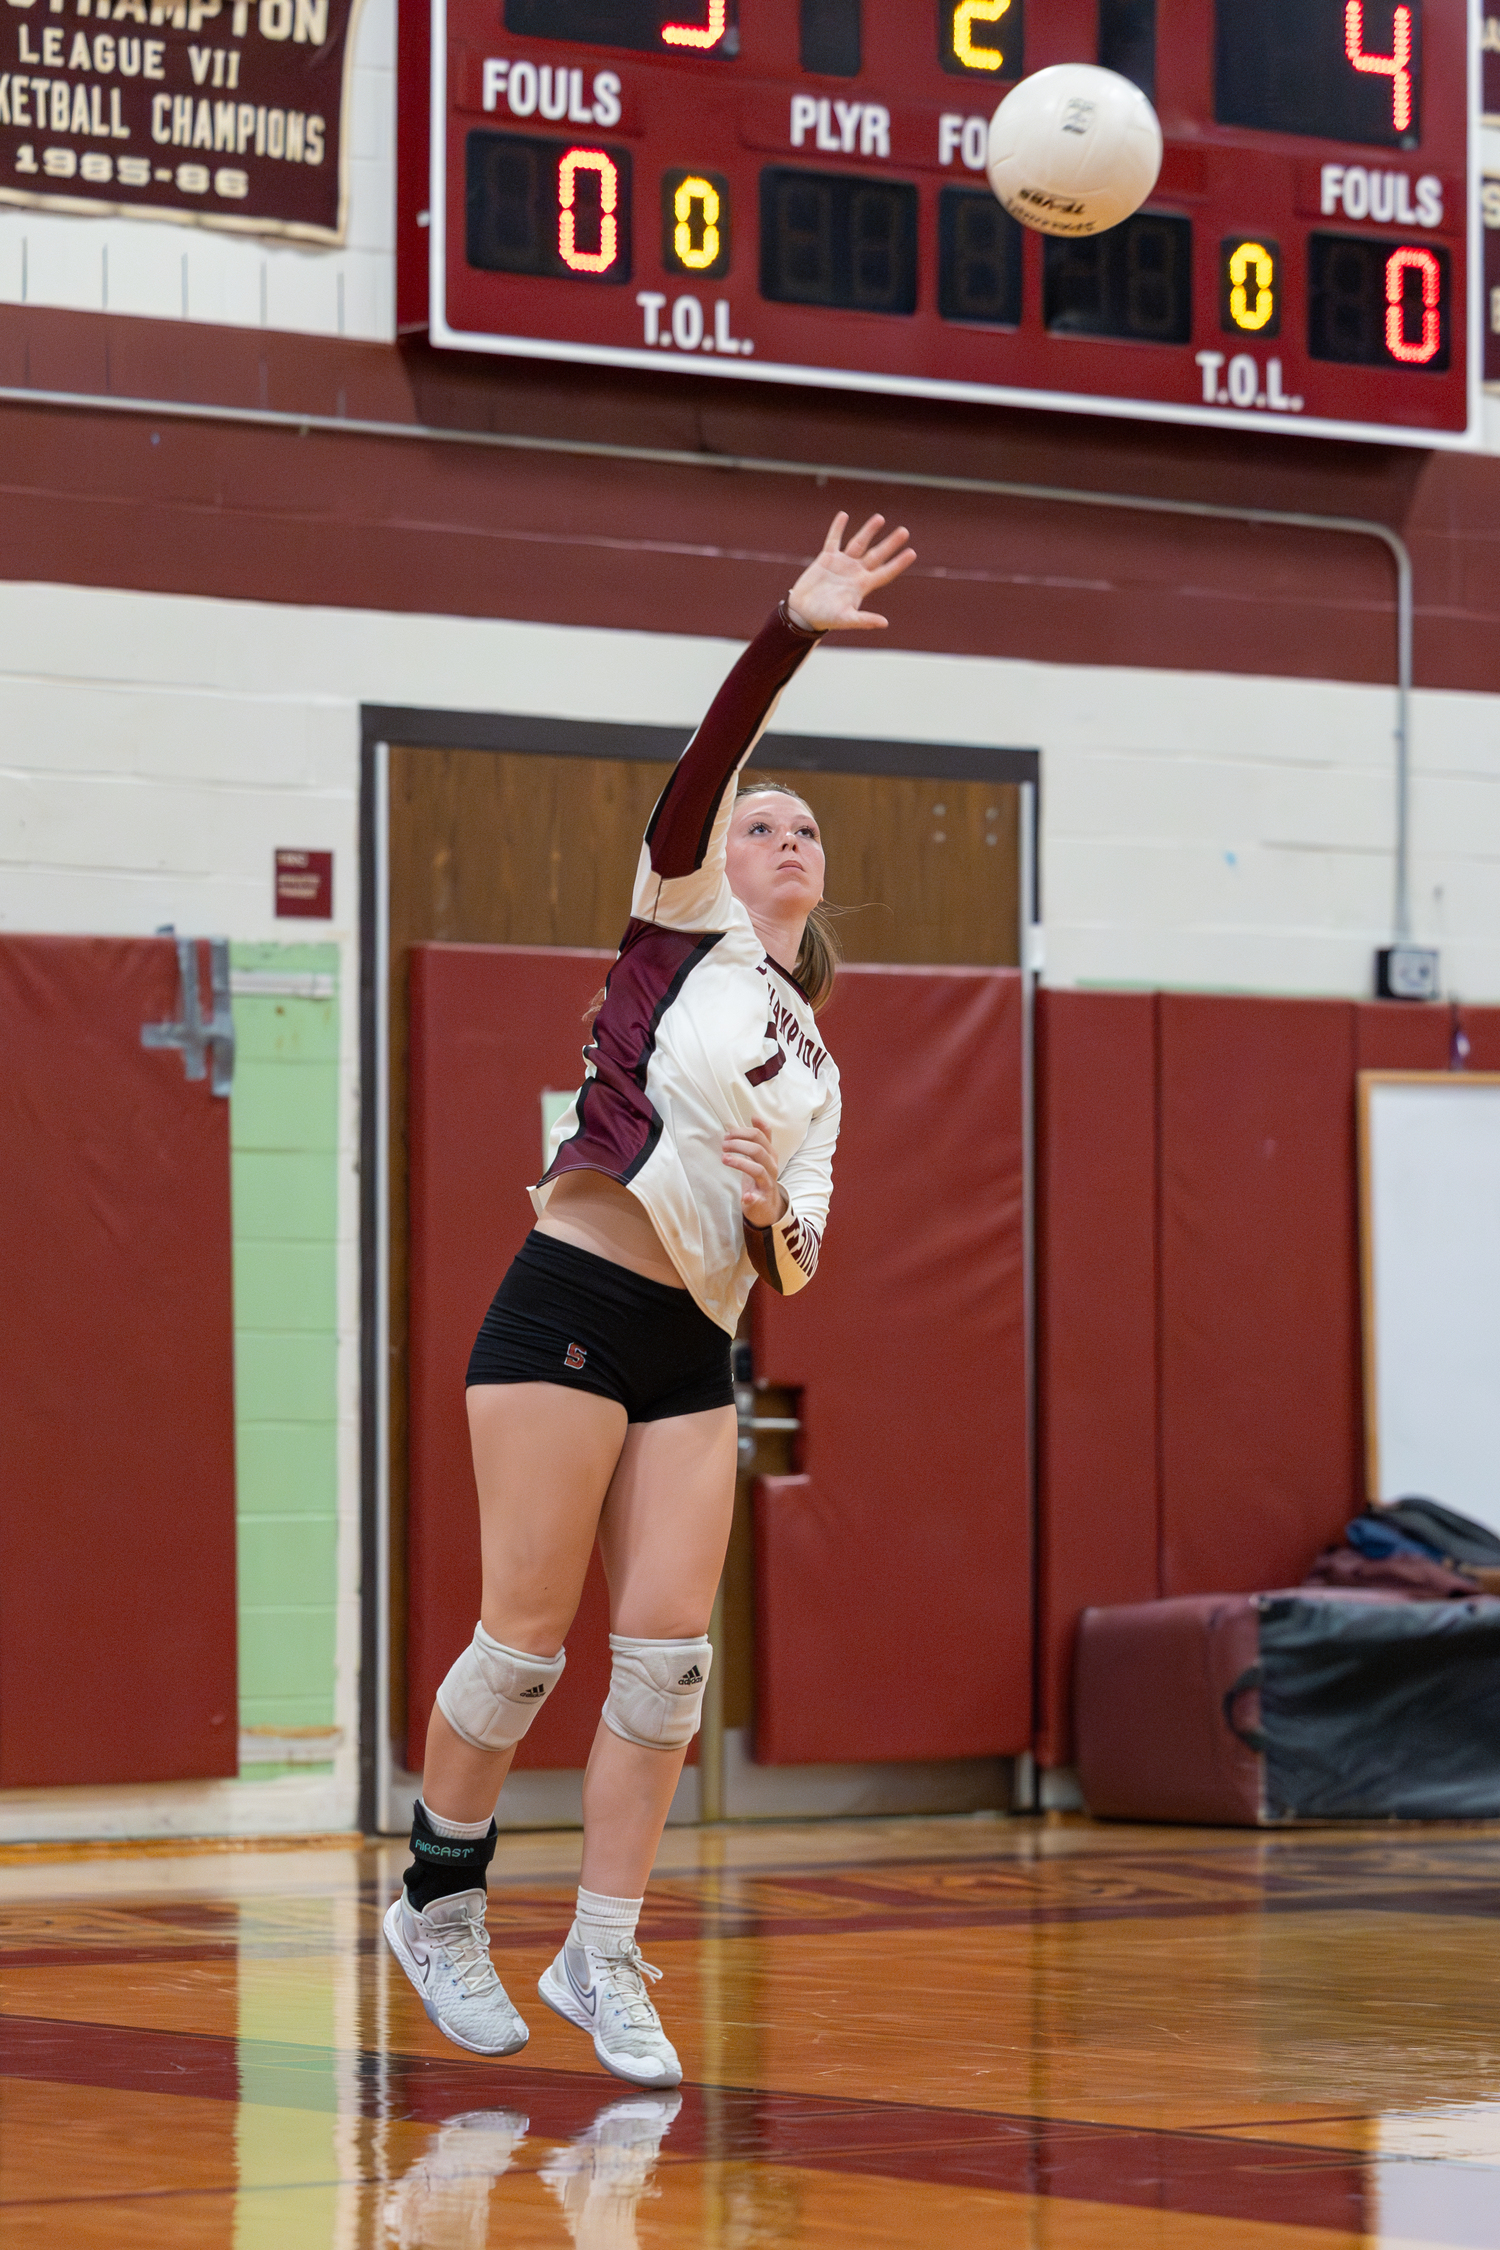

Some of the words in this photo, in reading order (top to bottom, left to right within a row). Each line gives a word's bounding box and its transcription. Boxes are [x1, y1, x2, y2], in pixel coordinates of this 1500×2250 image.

[19, 24, 165, 80] LEAGUE
[188, 45, 240, 89] VII
[1344, 0, 1411, 131] 4
[482, 58, 621, 127] FOULS
[790, 95, 890, 157] PLYR
[152, 93, 325, 166] CHAMPIONS
[15, 145, 248, 199] 1985-86
[1321, 164, 1443, 227] FOULS
[558, 146, 618, 273] 0
[674, 175, 720, 270] 0
[1229, 241, 1274, 331] 0
[1386, 246, 1440, 364] 0
[636, 292, 754, 355] T.O.L.
[1196, 351, 1304, 411] T.O.L.
[564, 1342, 587, 1370] S
